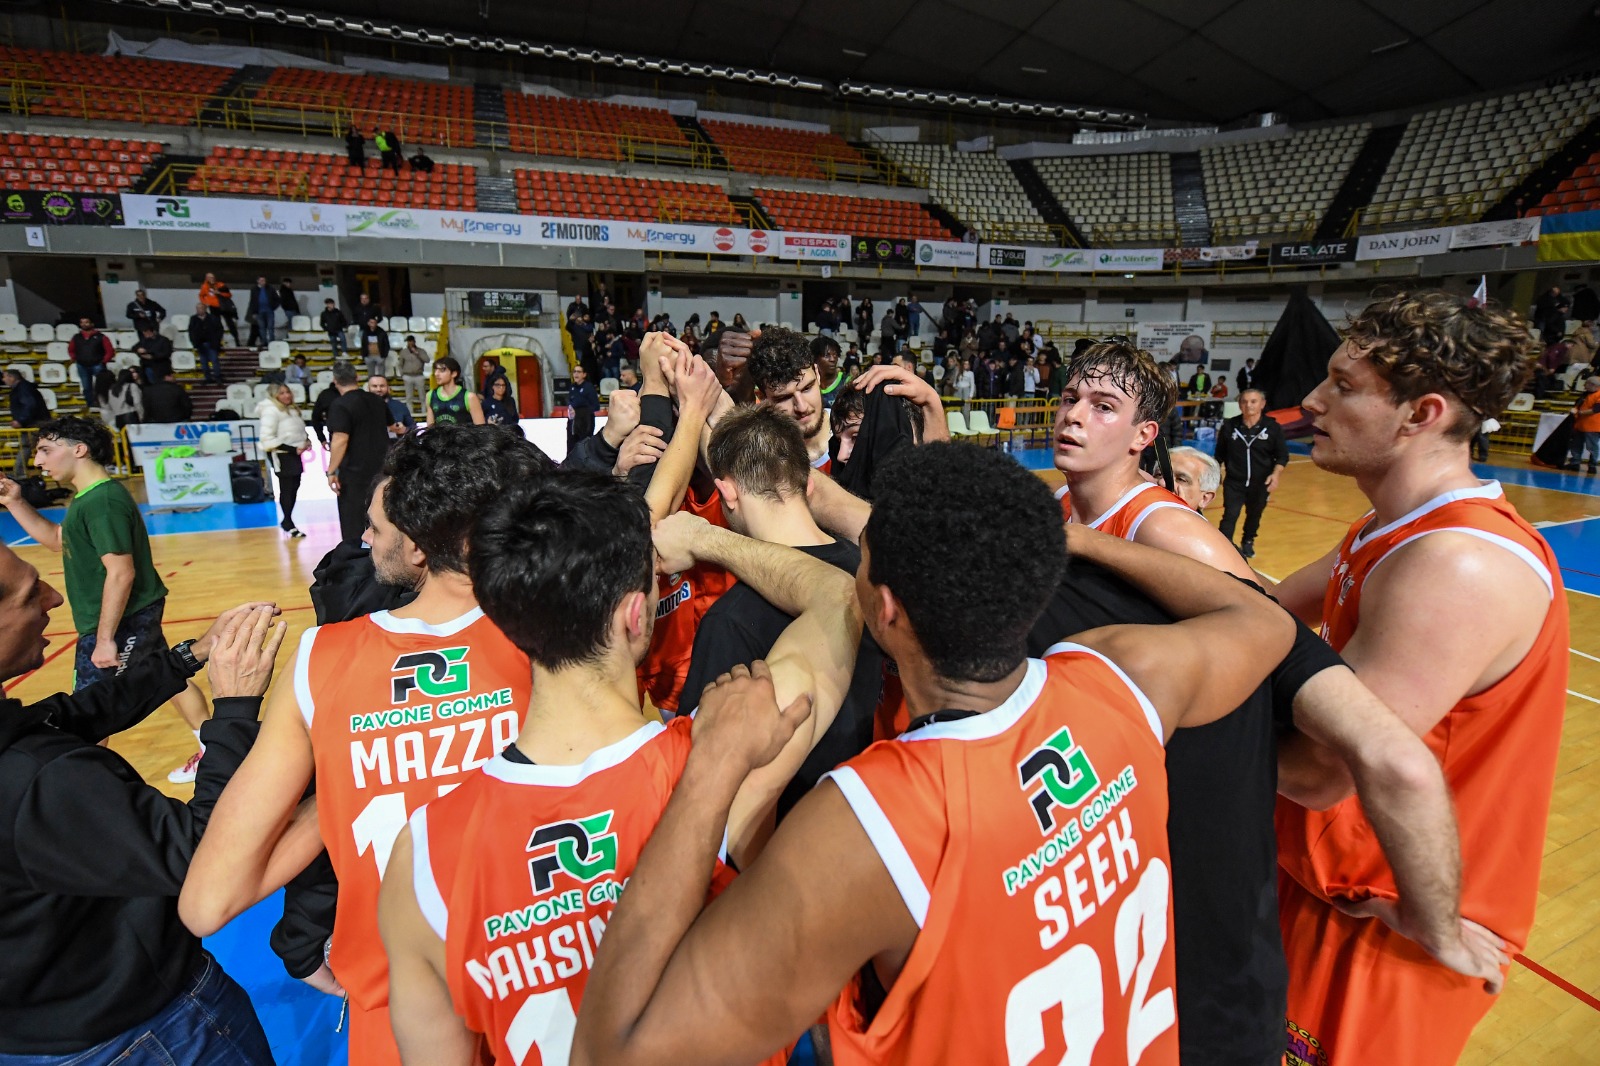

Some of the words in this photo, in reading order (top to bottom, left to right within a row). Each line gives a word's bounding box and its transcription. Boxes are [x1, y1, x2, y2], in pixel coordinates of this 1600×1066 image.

[138, 219, 175, 228] PAVONE
[178, 221, 211, 229] GOMME
[250, 219, 287, 232] Lievito
[300, 220, 335, 233] Lievito
[441, 217, 522, 236] MyEnergy
[541, 222, 610, 242] 2FMOTORS
[627, 227, 696, 245] MyEnergy
[793, 238, 837, 248] DESPAR
[1369, 238, 1399, 250] DAN
[1401, 234, 1441, 250] JOHN
[1281, 243, 1348, 257] ELEVATE
[174, 423, 232, 440] AVIS
[351, 704, 431, 733] PAVONE
[437, 688, 512, 718] GOMME
[350, 710, 519, 789] MAZZA
[351, 782, 463, 884] 1
[1003, 815, 1084, 896] PAVONE
[1079, 764, 1138, 831] GOMME
[1034, 806, 1140, 950] SEEK
[484, 890, 584, 941] PAVONE
